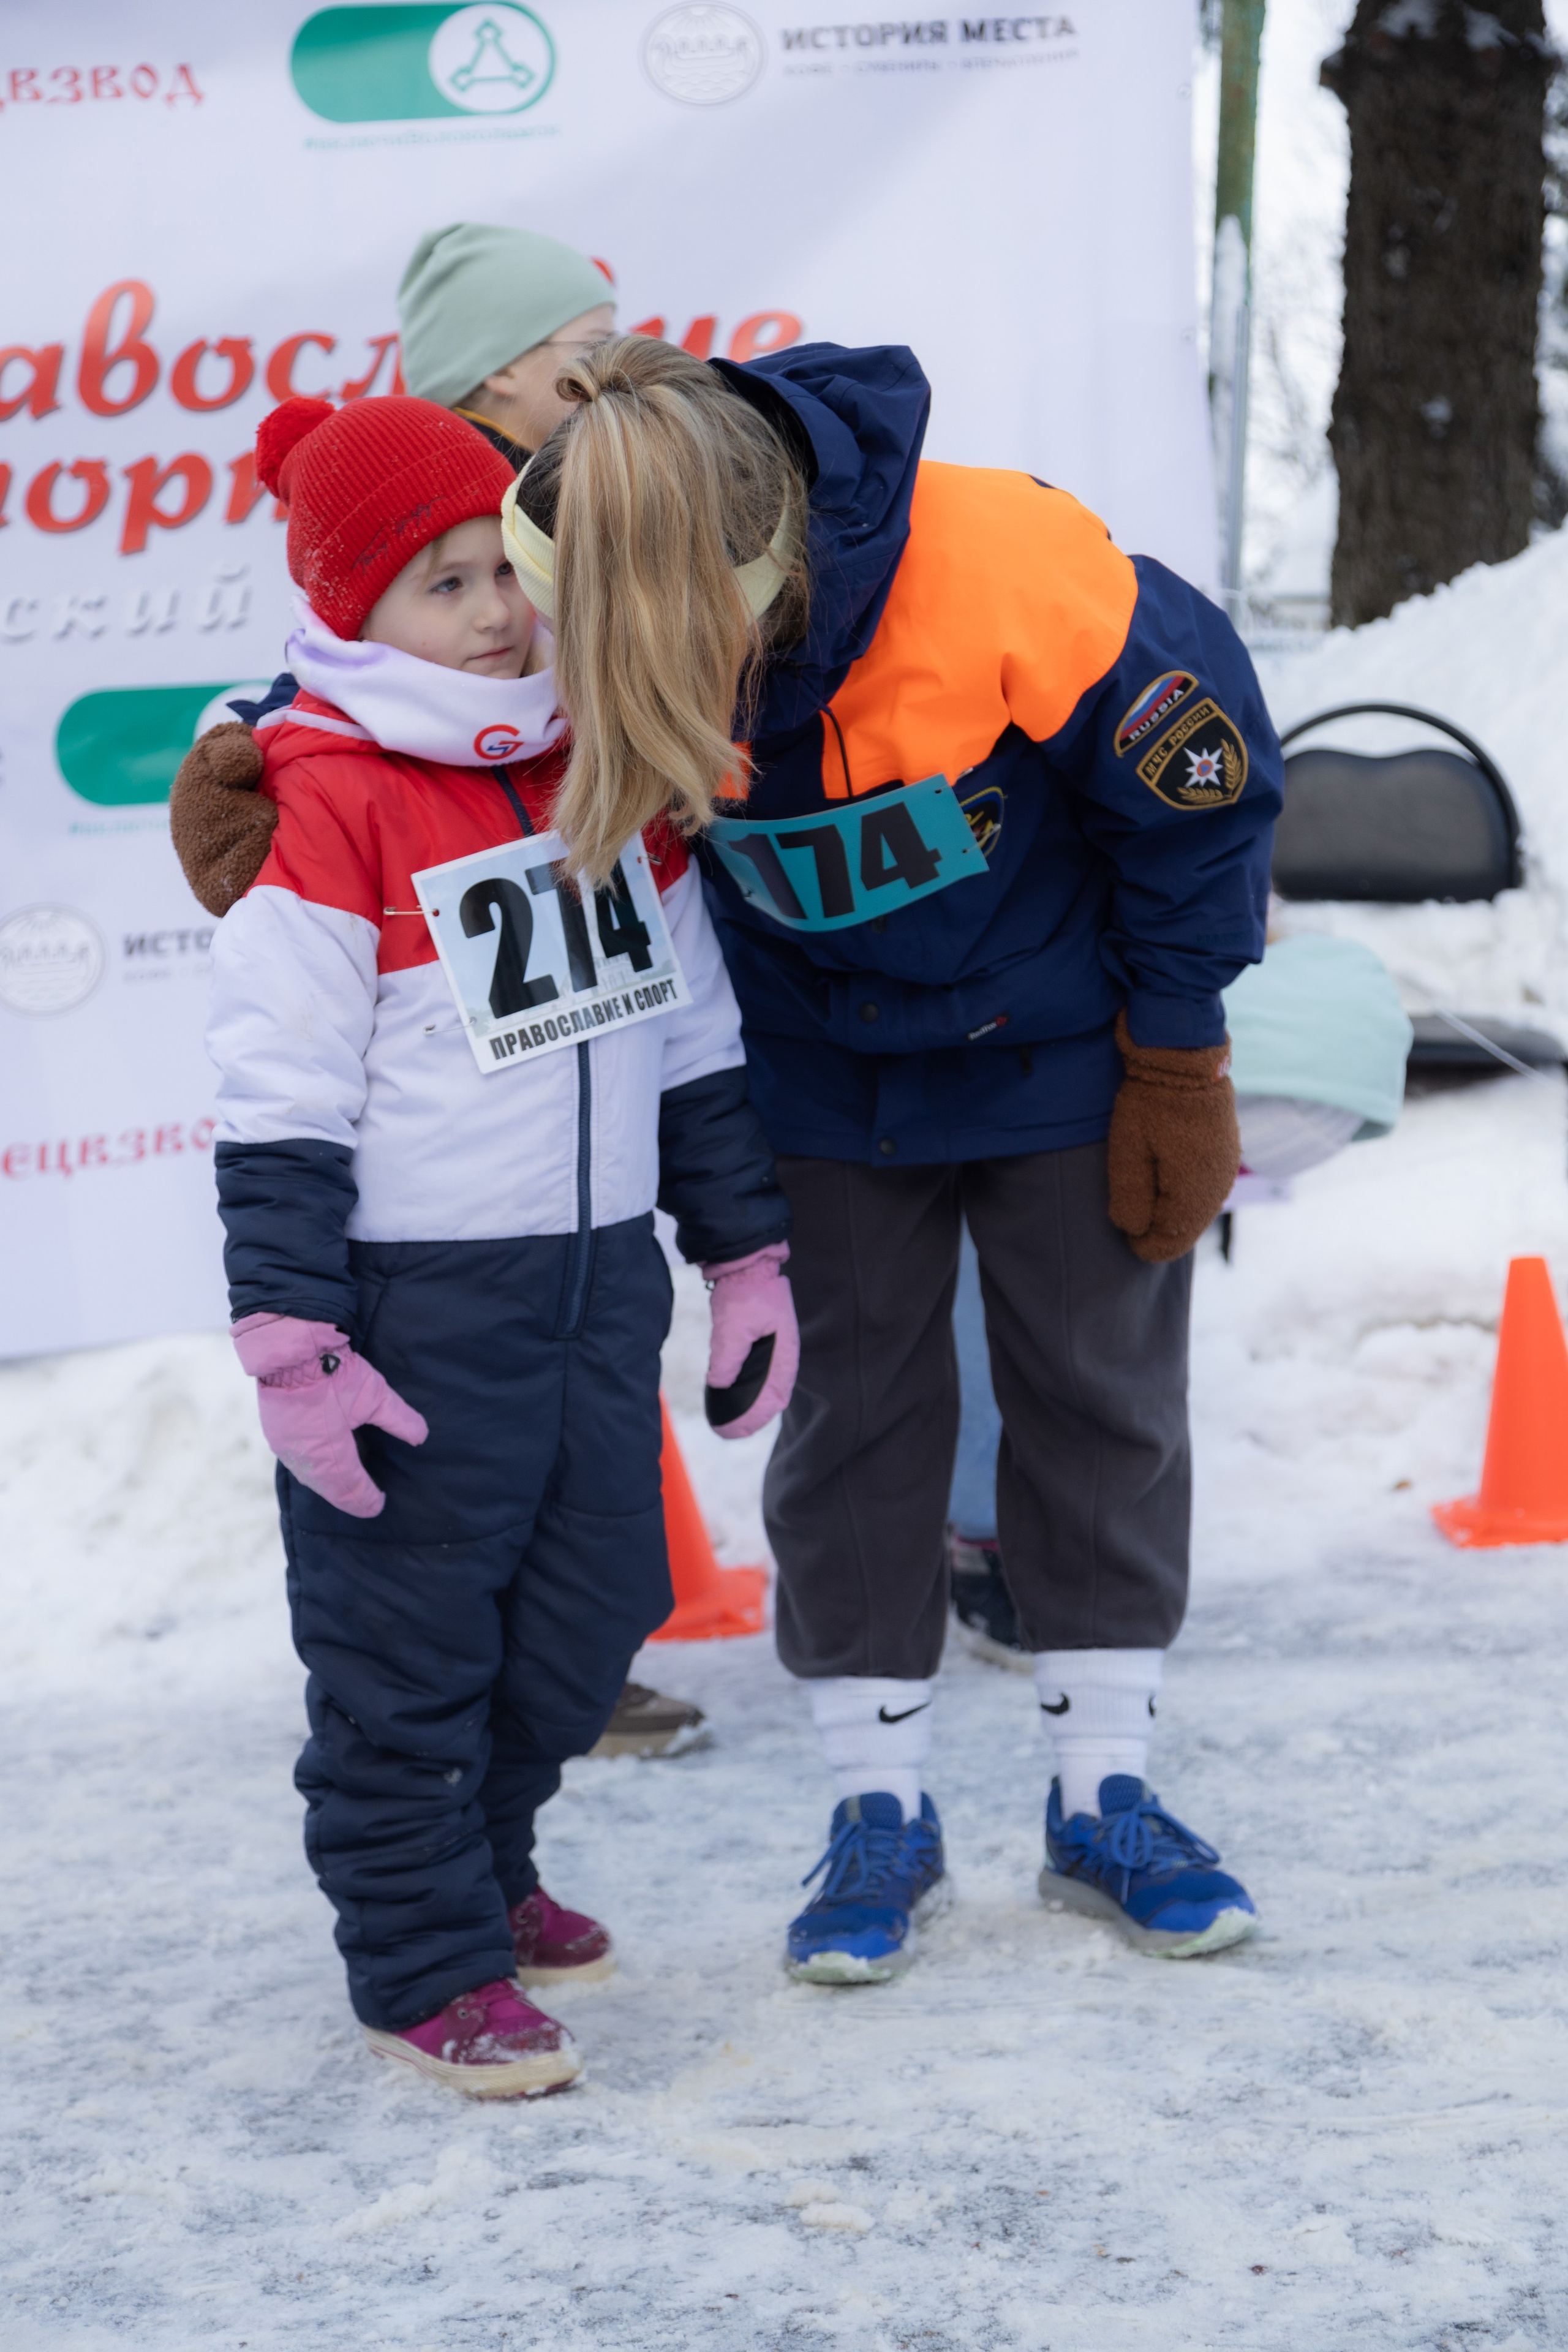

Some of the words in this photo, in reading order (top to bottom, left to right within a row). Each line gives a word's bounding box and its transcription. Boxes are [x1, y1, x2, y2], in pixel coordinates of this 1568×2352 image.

[782, 20, 948, 51] ИСТОРИЯ
[960, 15, 1077, 43] МЕСТА
[0, 62, 205, 112] ВЗВОД
[1128, 688, 1185, 741] RUSSIA
[1145, 747, 1169, 777] МЧС
[1168, 706, 1210, 746] РОССИИ
[727, 801, 943, 920] 174
[459, 857, 654, 1019] 274
[489, 997, 624, 1060] ПРАВОСЛАВИЕ
[622, 993, 636, 1015] И
[634, 978, 679, 1010] СПОРТ
